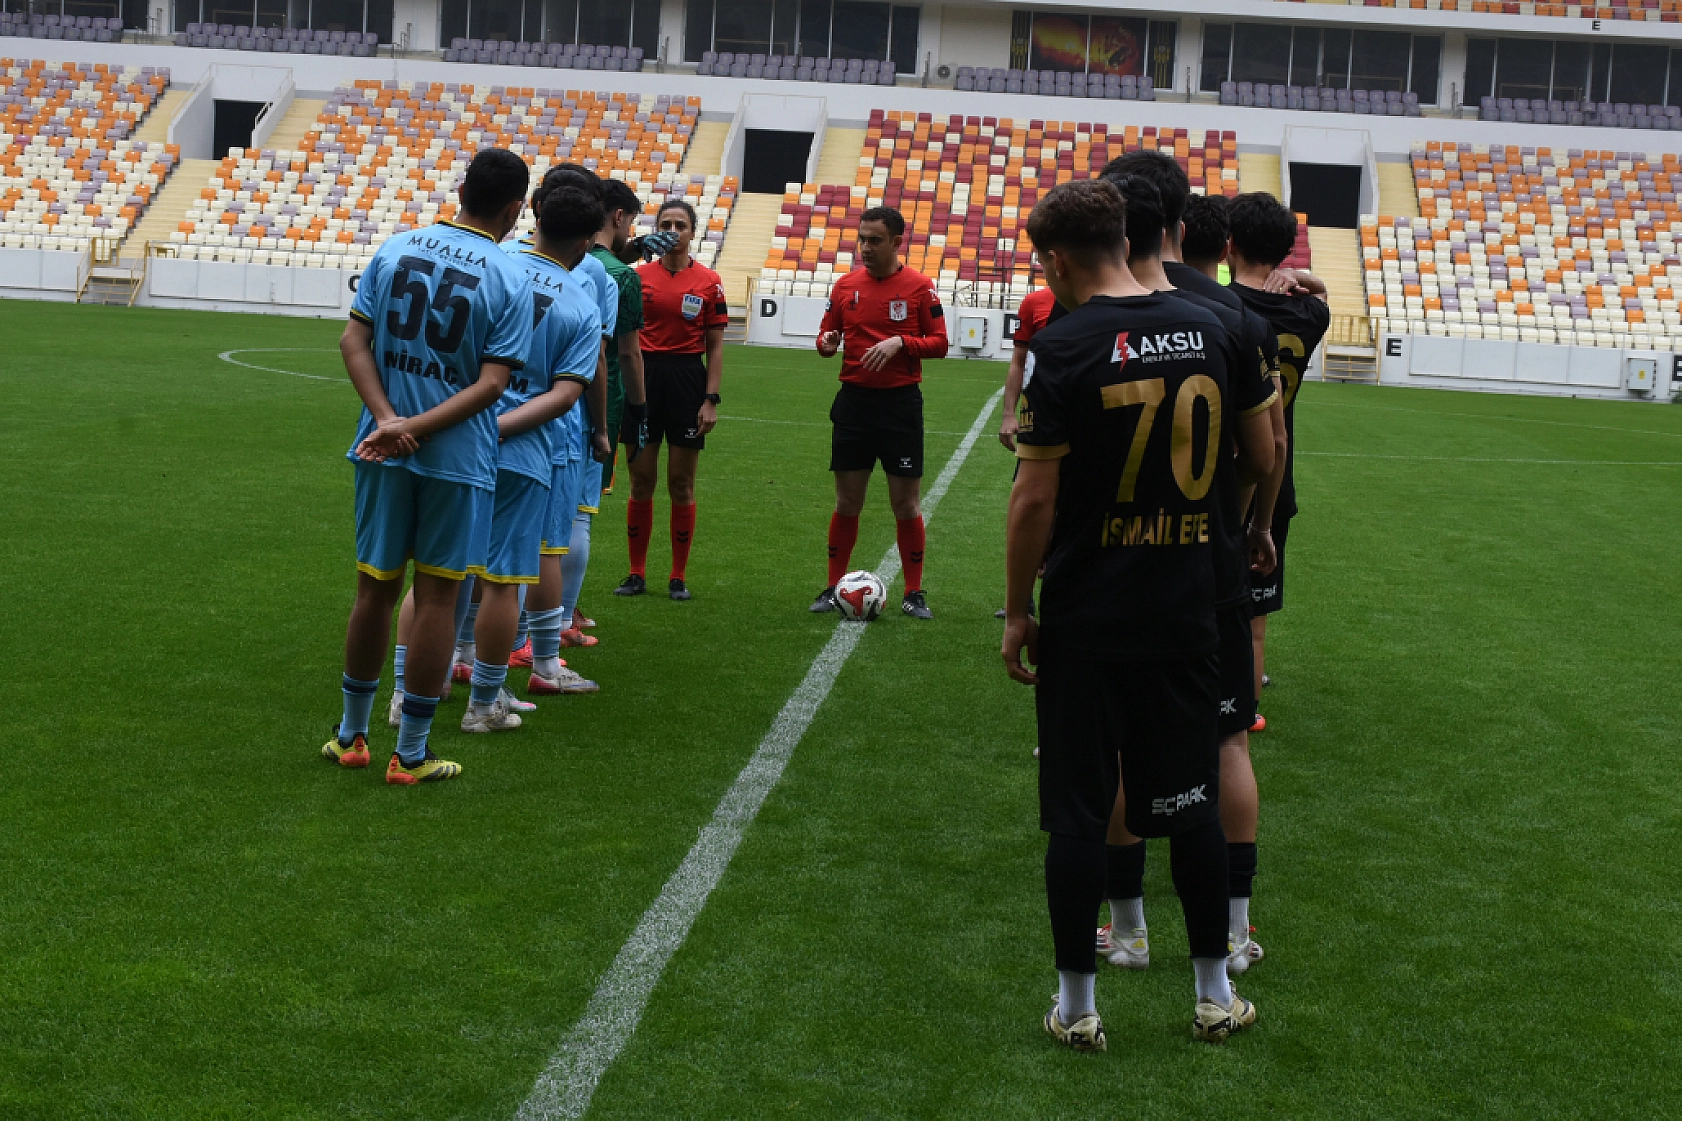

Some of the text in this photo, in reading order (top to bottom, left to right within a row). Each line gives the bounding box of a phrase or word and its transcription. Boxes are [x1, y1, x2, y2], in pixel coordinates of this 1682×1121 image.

[1592, 21, 1601, 31] E
[406, 234, 487, 269] MUALLA
[387, 255, 482, 354] 55
[759, 299, 778, 318] D
[1140, 331, 1204, 356] AKSU
[1386, 338, 1401, 357] E
[1100, 374, 1222, 503] 70
[1101, 507, 1174, 548] İSMAİL
